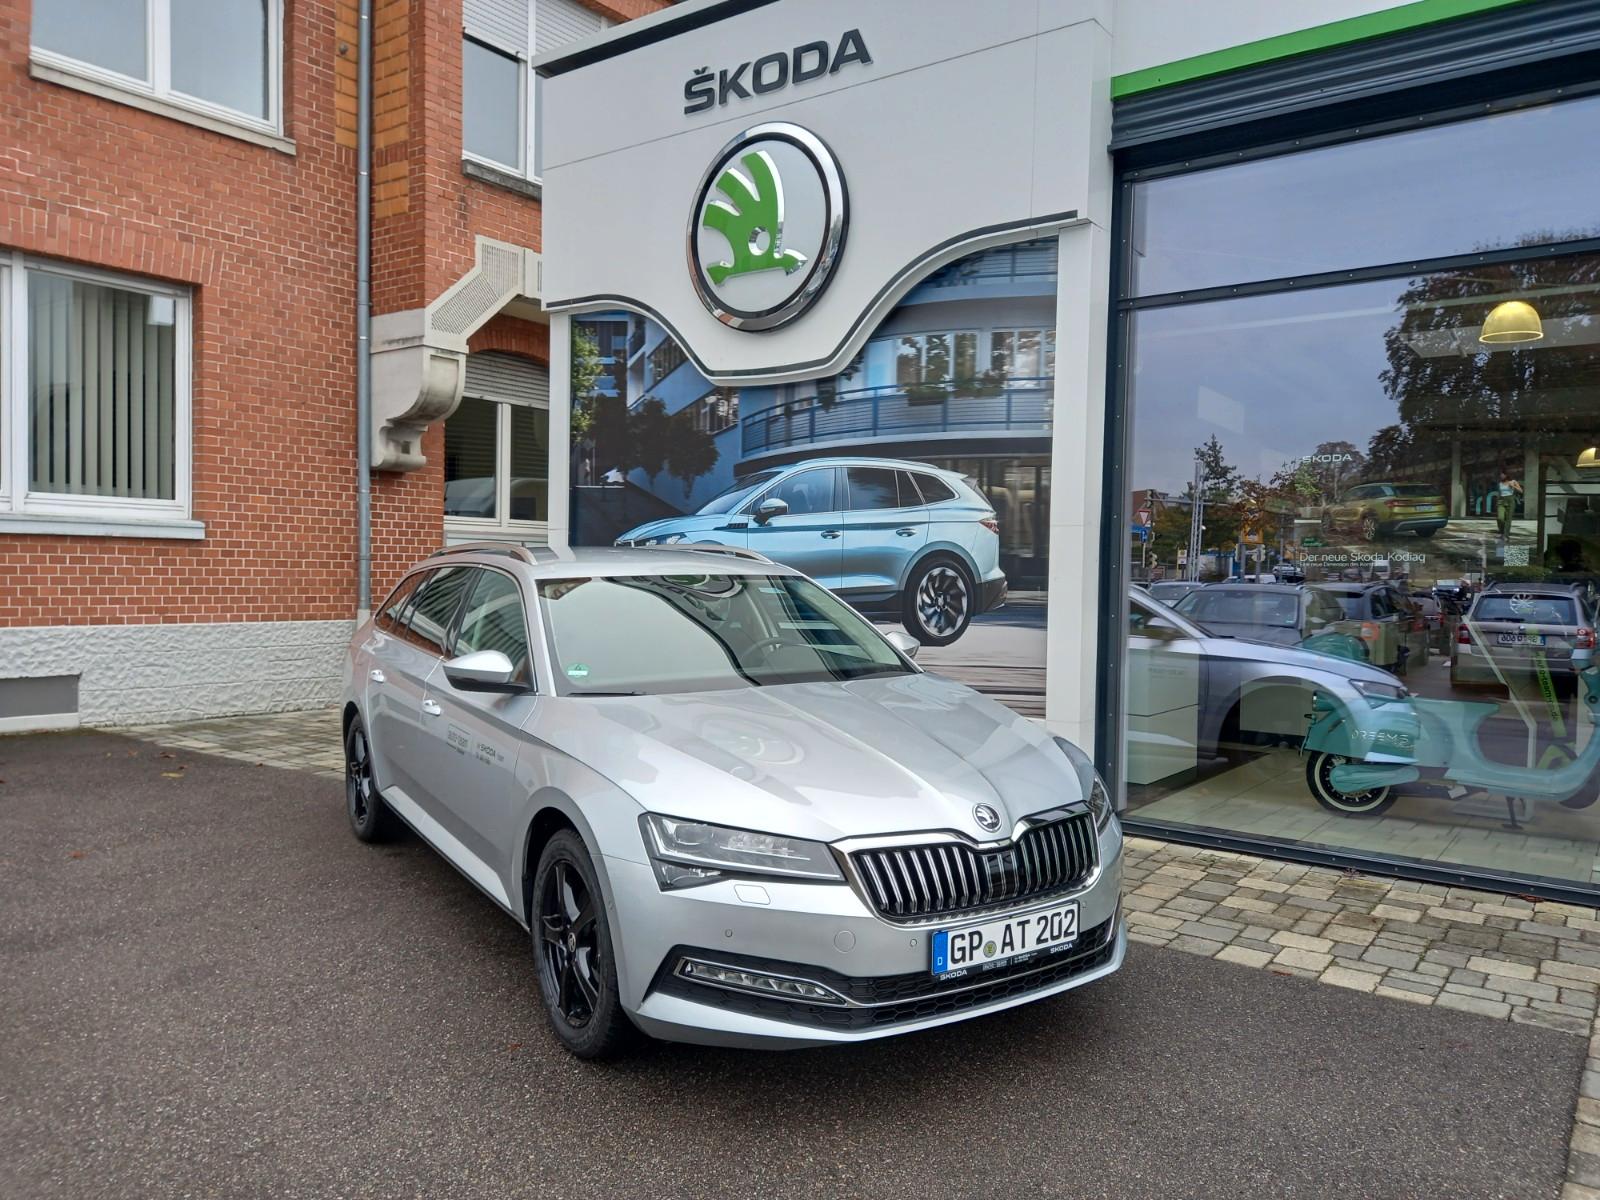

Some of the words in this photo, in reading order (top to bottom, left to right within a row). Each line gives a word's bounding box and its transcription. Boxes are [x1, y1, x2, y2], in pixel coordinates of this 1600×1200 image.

[684, 28, 873, 115] ŠKODA
[1300, 552, 1319, 562] Der
[1321, 554, 1347, 562] neue
[1350, 552, 1384, 562] Skoda
[951, 930, 983, 964] GP
[1000, 919, 1031, 954] AT
[1036, 909, 1075, 944] 202
[937, 956, 943, 966] D
